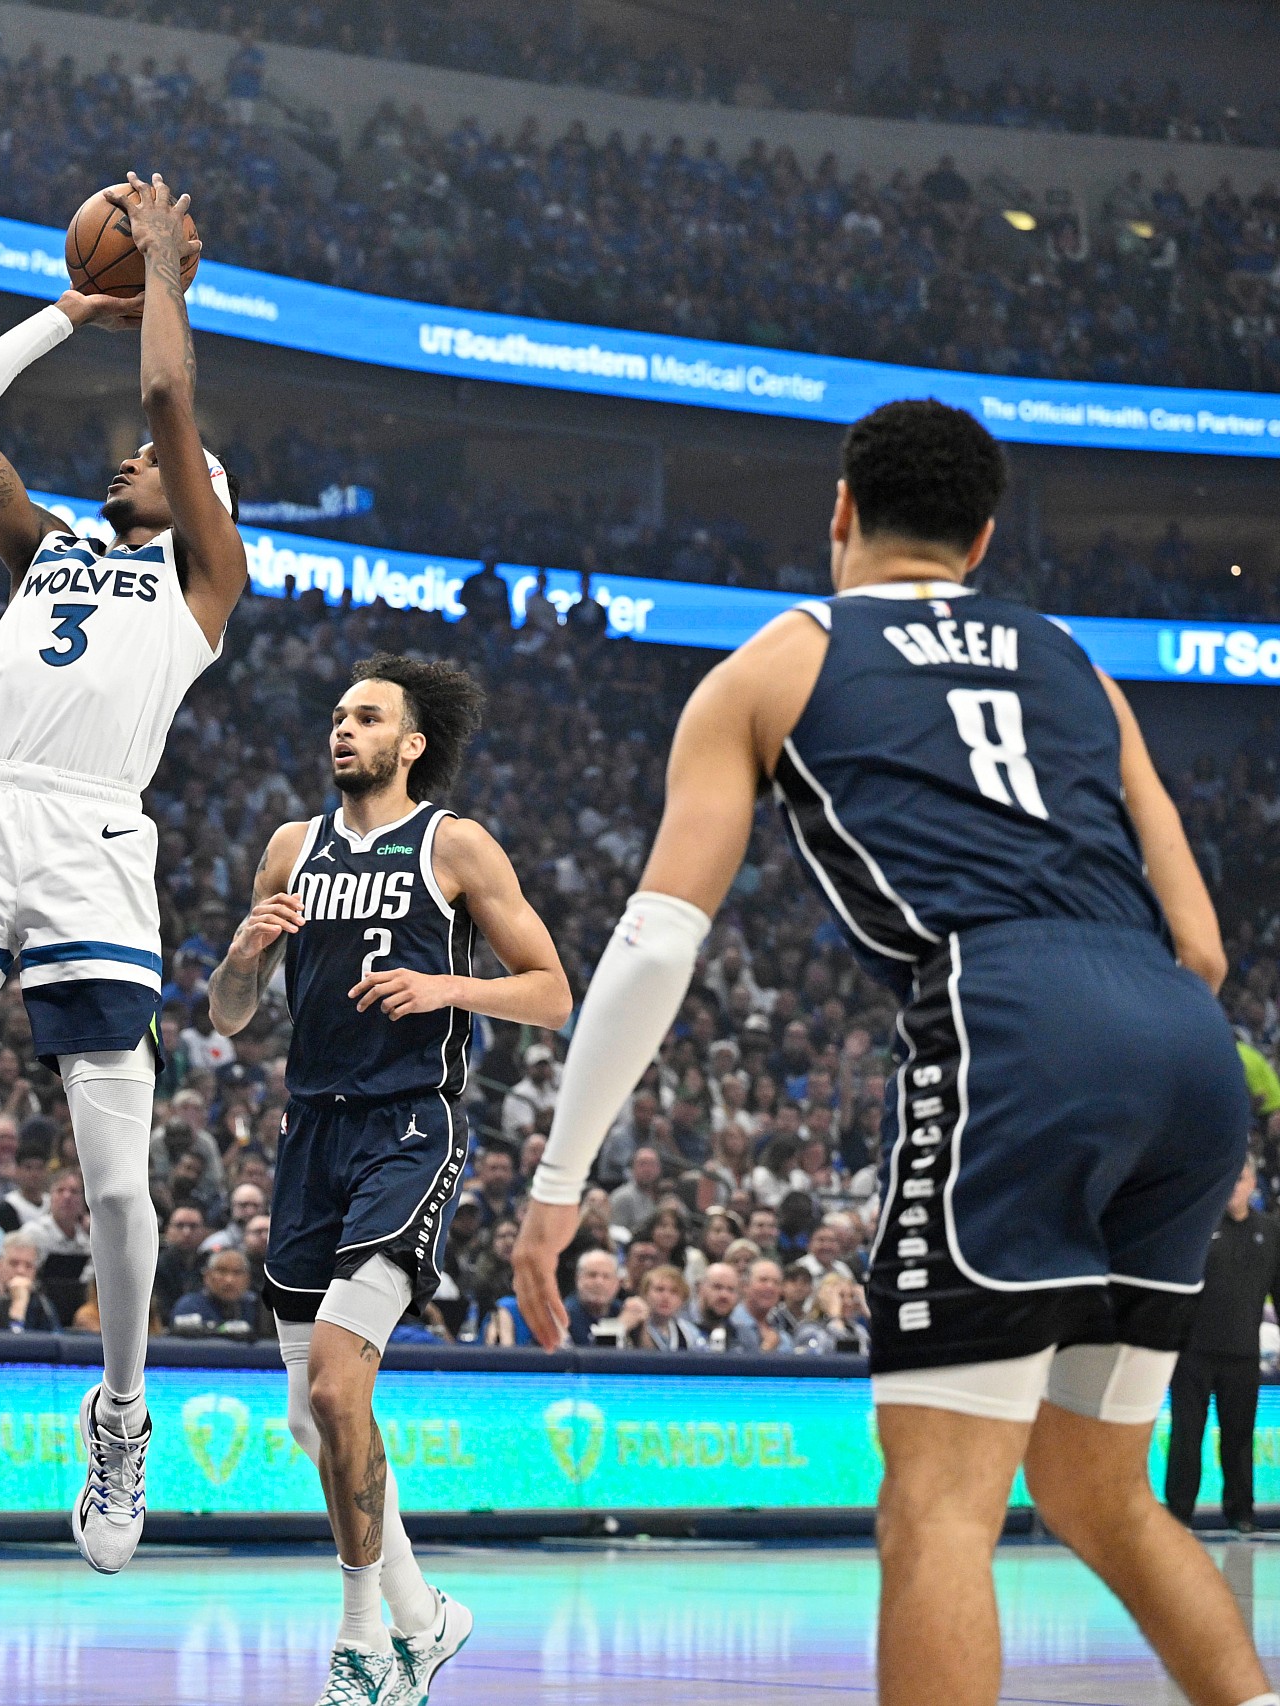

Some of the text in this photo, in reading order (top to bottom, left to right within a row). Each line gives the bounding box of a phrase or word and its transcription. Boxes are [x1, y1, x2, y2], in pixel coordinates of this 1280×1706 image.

[420, 323, 828, 401] UTSouthwestern Medical Center
[980, 395, 1017, 421] The
[1017, 399, 1086, 426] Official
[1086, 402, 1149, 431] Health
[1149, 407, 1196, 433] Care
[23, 567, 159, 603] WOLVES
[352, 555, 467, 616] Medic
[38, 603, 99, 668] 3
[882, 619, 1019, 672] GREEN
[946, 688, 1050, 820] 8
[376, 843, 414, 855] chime
[298, 871, 415, 921] MAVS
[361, 927, 393, 982] 2
[616, 1421, 809, 1468] FANDUEL
